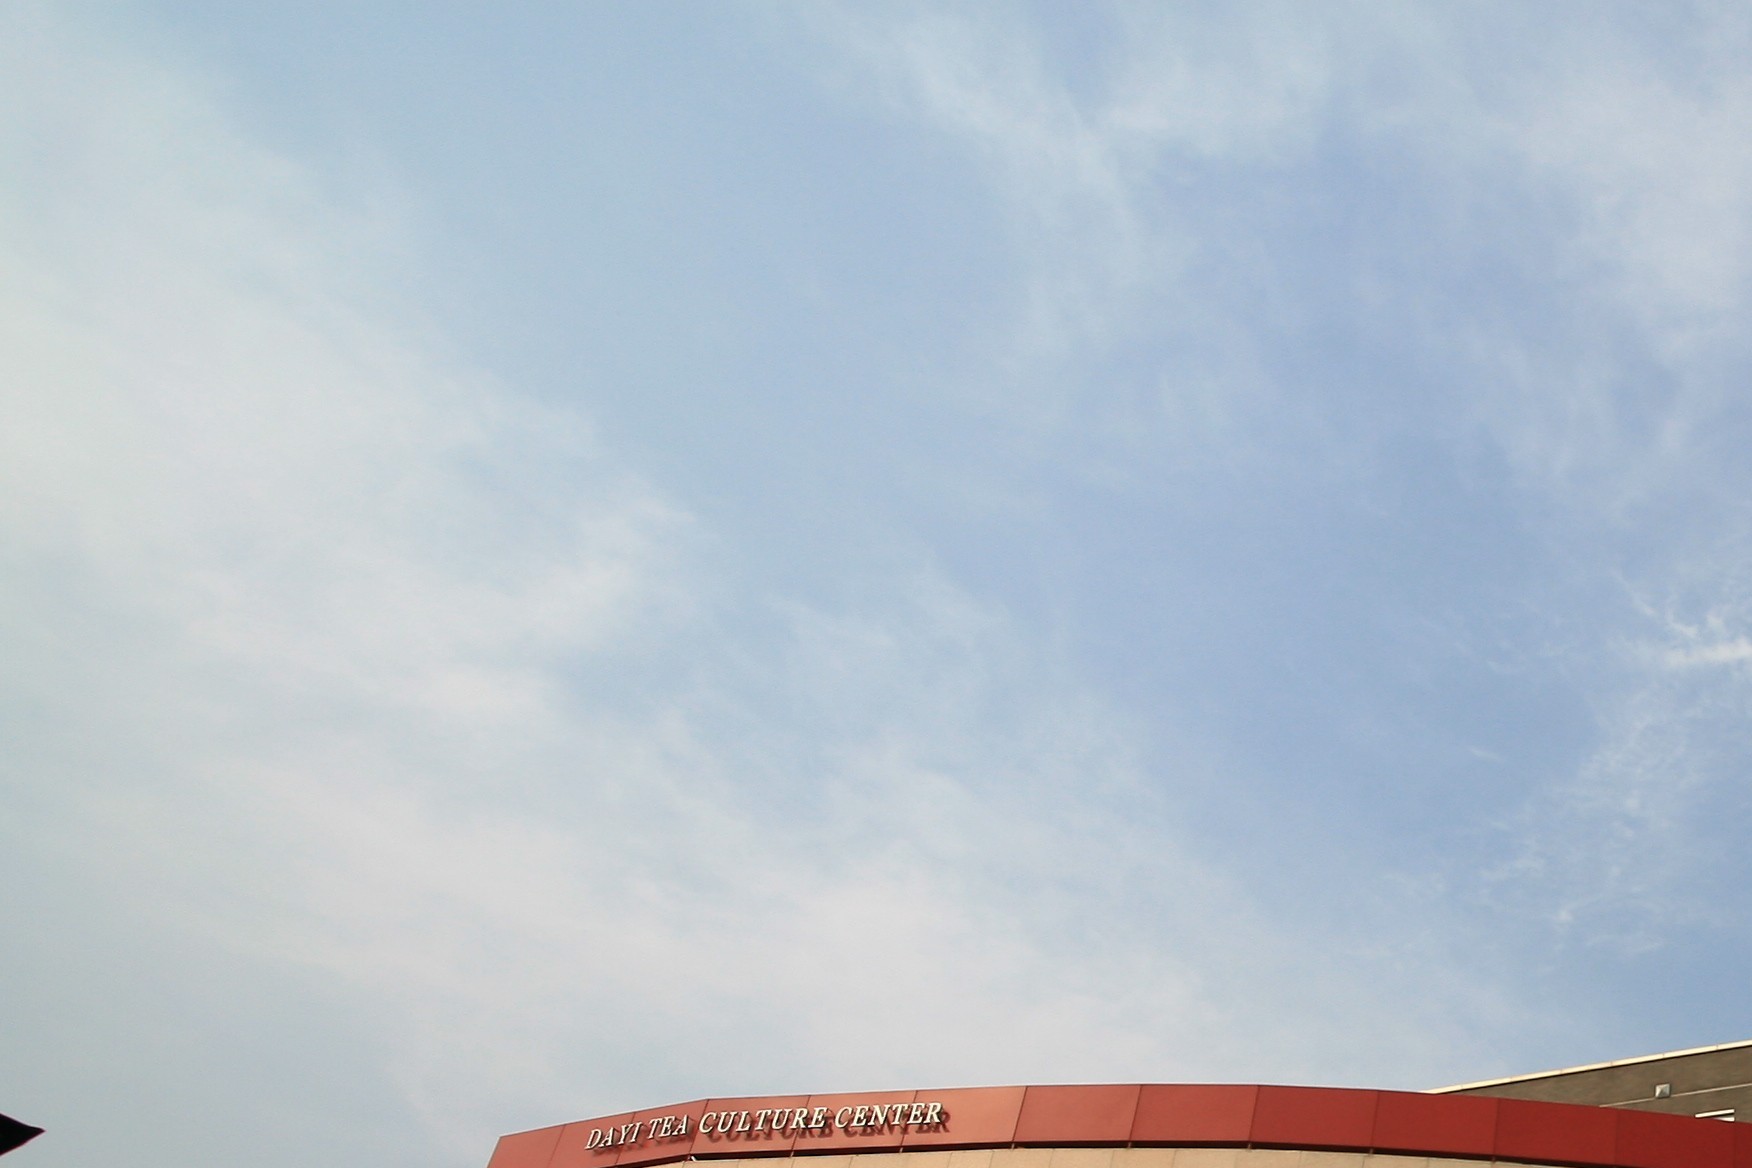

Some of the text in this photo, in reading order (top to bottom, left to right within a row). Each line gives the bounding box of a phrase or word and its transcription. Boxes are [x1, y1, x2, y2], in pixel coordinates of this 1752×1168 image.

[585, 1102, 943, 1151] DAYI TEA CULTURE CENTER
